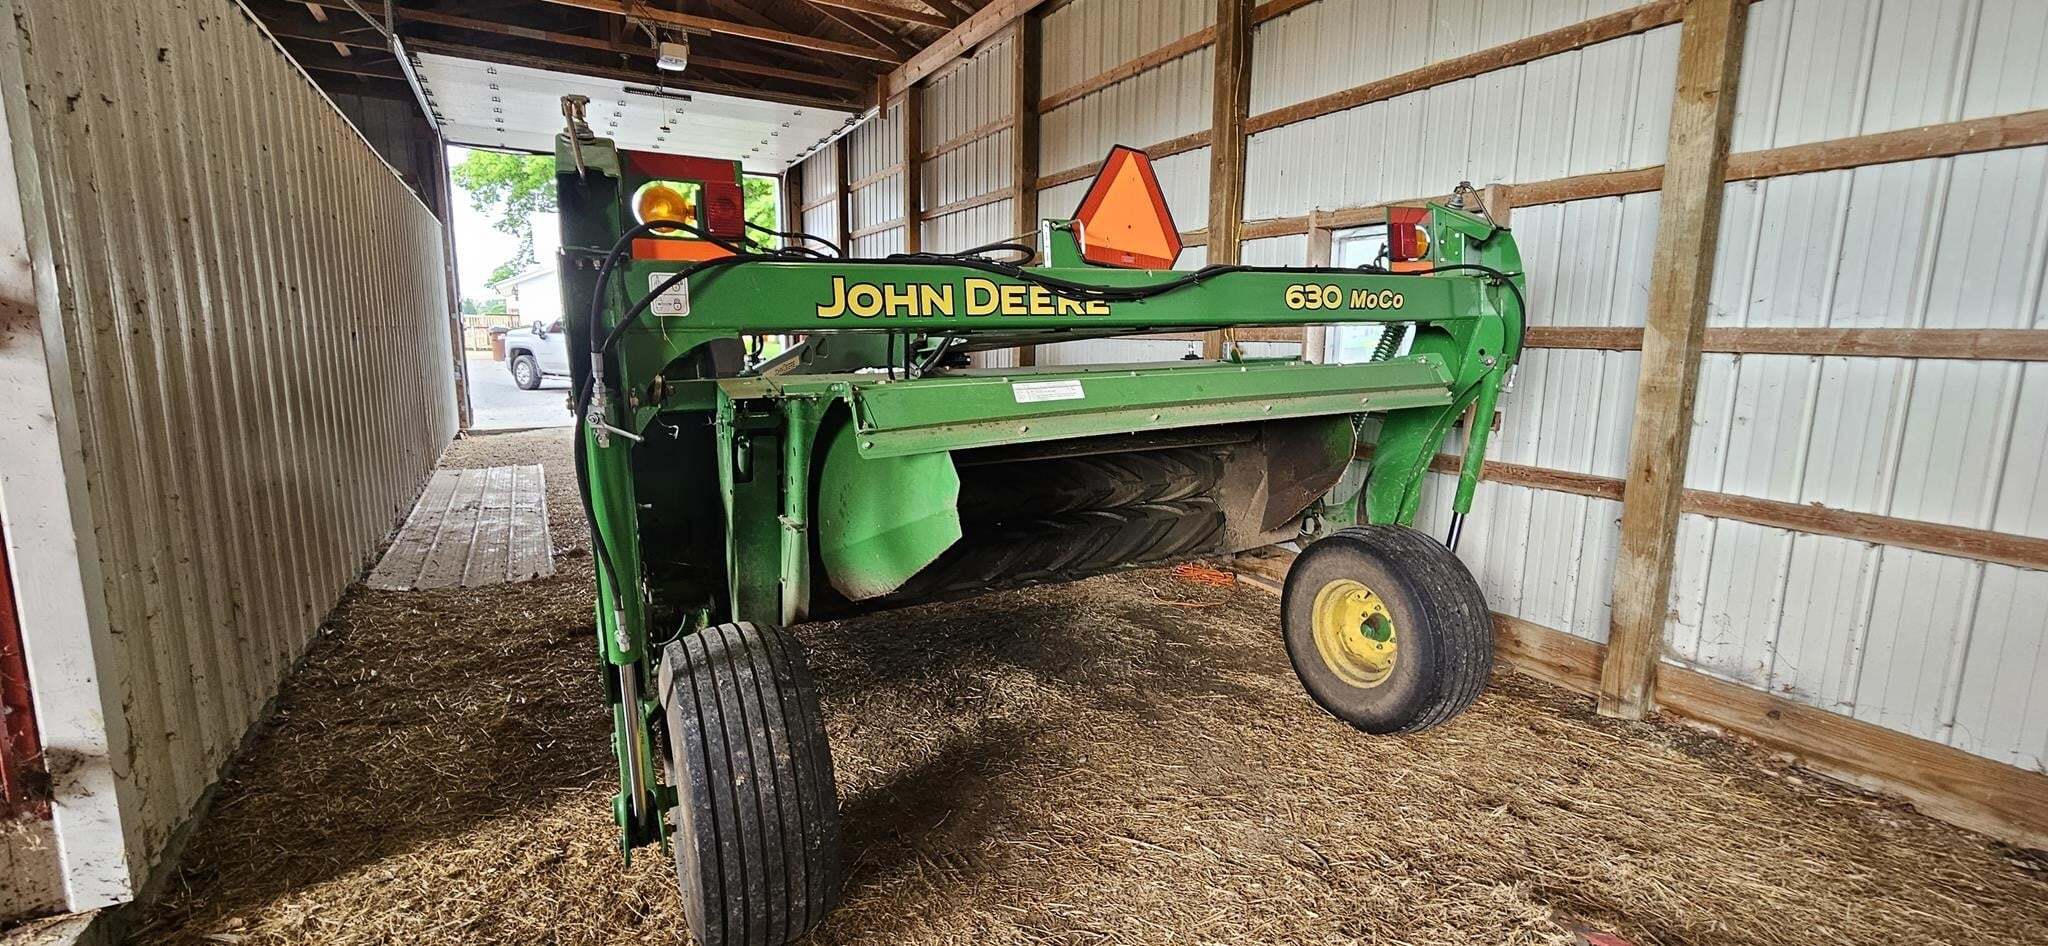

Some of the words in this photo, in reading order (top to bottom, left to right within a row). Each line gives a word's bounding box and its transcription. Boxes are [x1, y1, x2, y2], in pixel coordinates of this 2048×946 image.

[816, 276, 956, 319] JOHN
[1285, 283, 1343, 310] 630
[1349, 288, 1404, 310] MoCo
